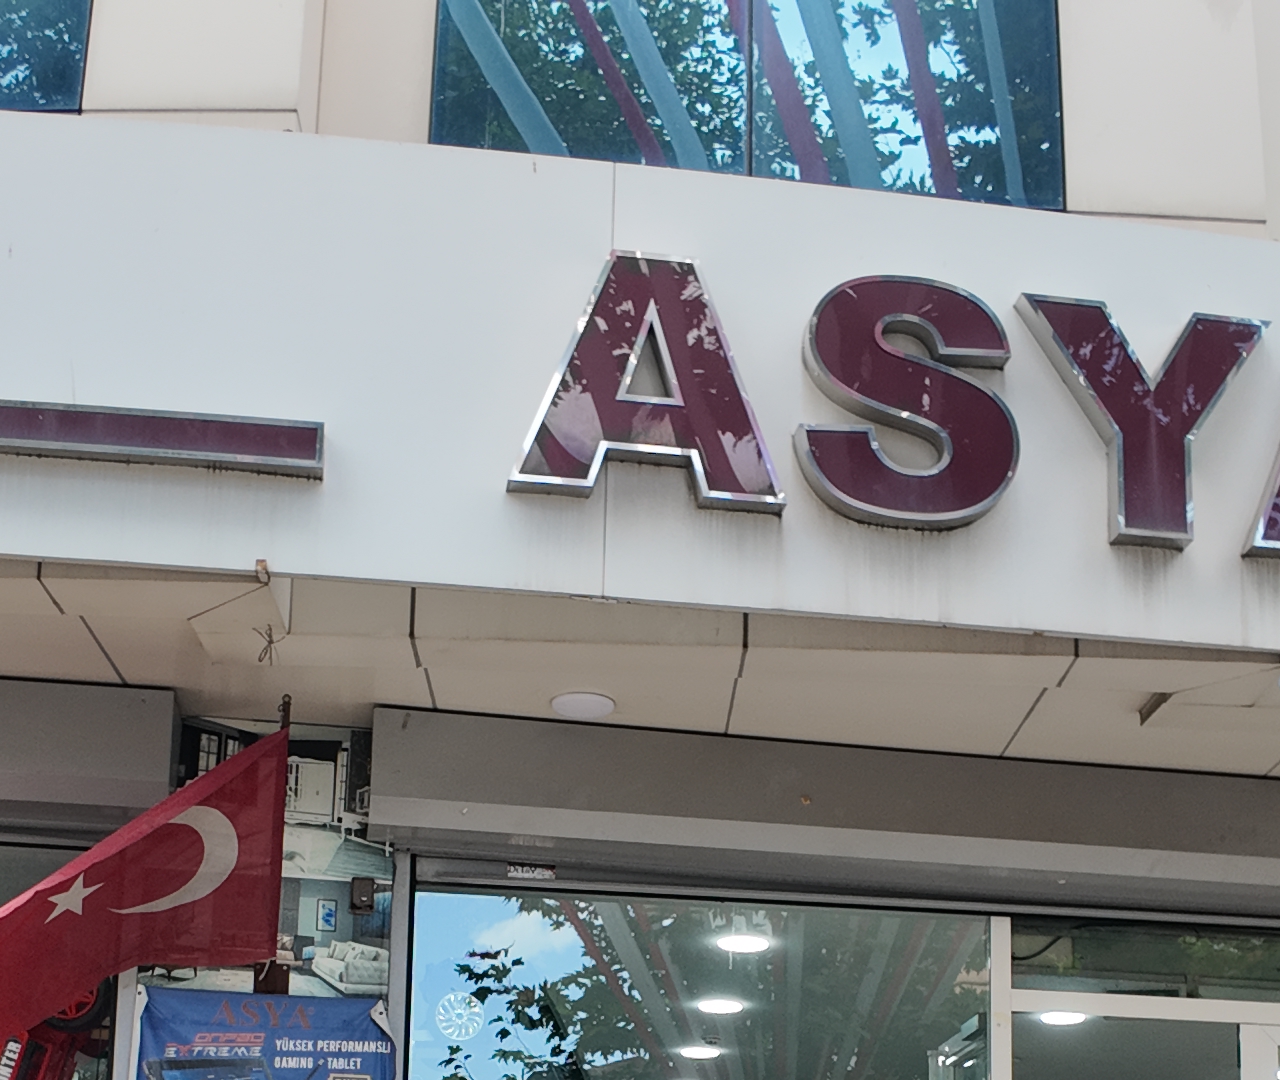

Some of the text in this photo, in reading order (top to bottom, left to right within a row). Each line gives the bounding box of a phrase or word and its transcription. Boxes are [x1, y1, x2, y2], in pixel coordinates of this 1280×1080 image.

[212, 1000, 312, 1030] ASYA
[164, 1044, 263, 1058] EXTREME
[275, 1037, 391, 1053] YÜKSEK PERFORMANSLI
[274, 1056, 362, 1069] GAMING TABLET
